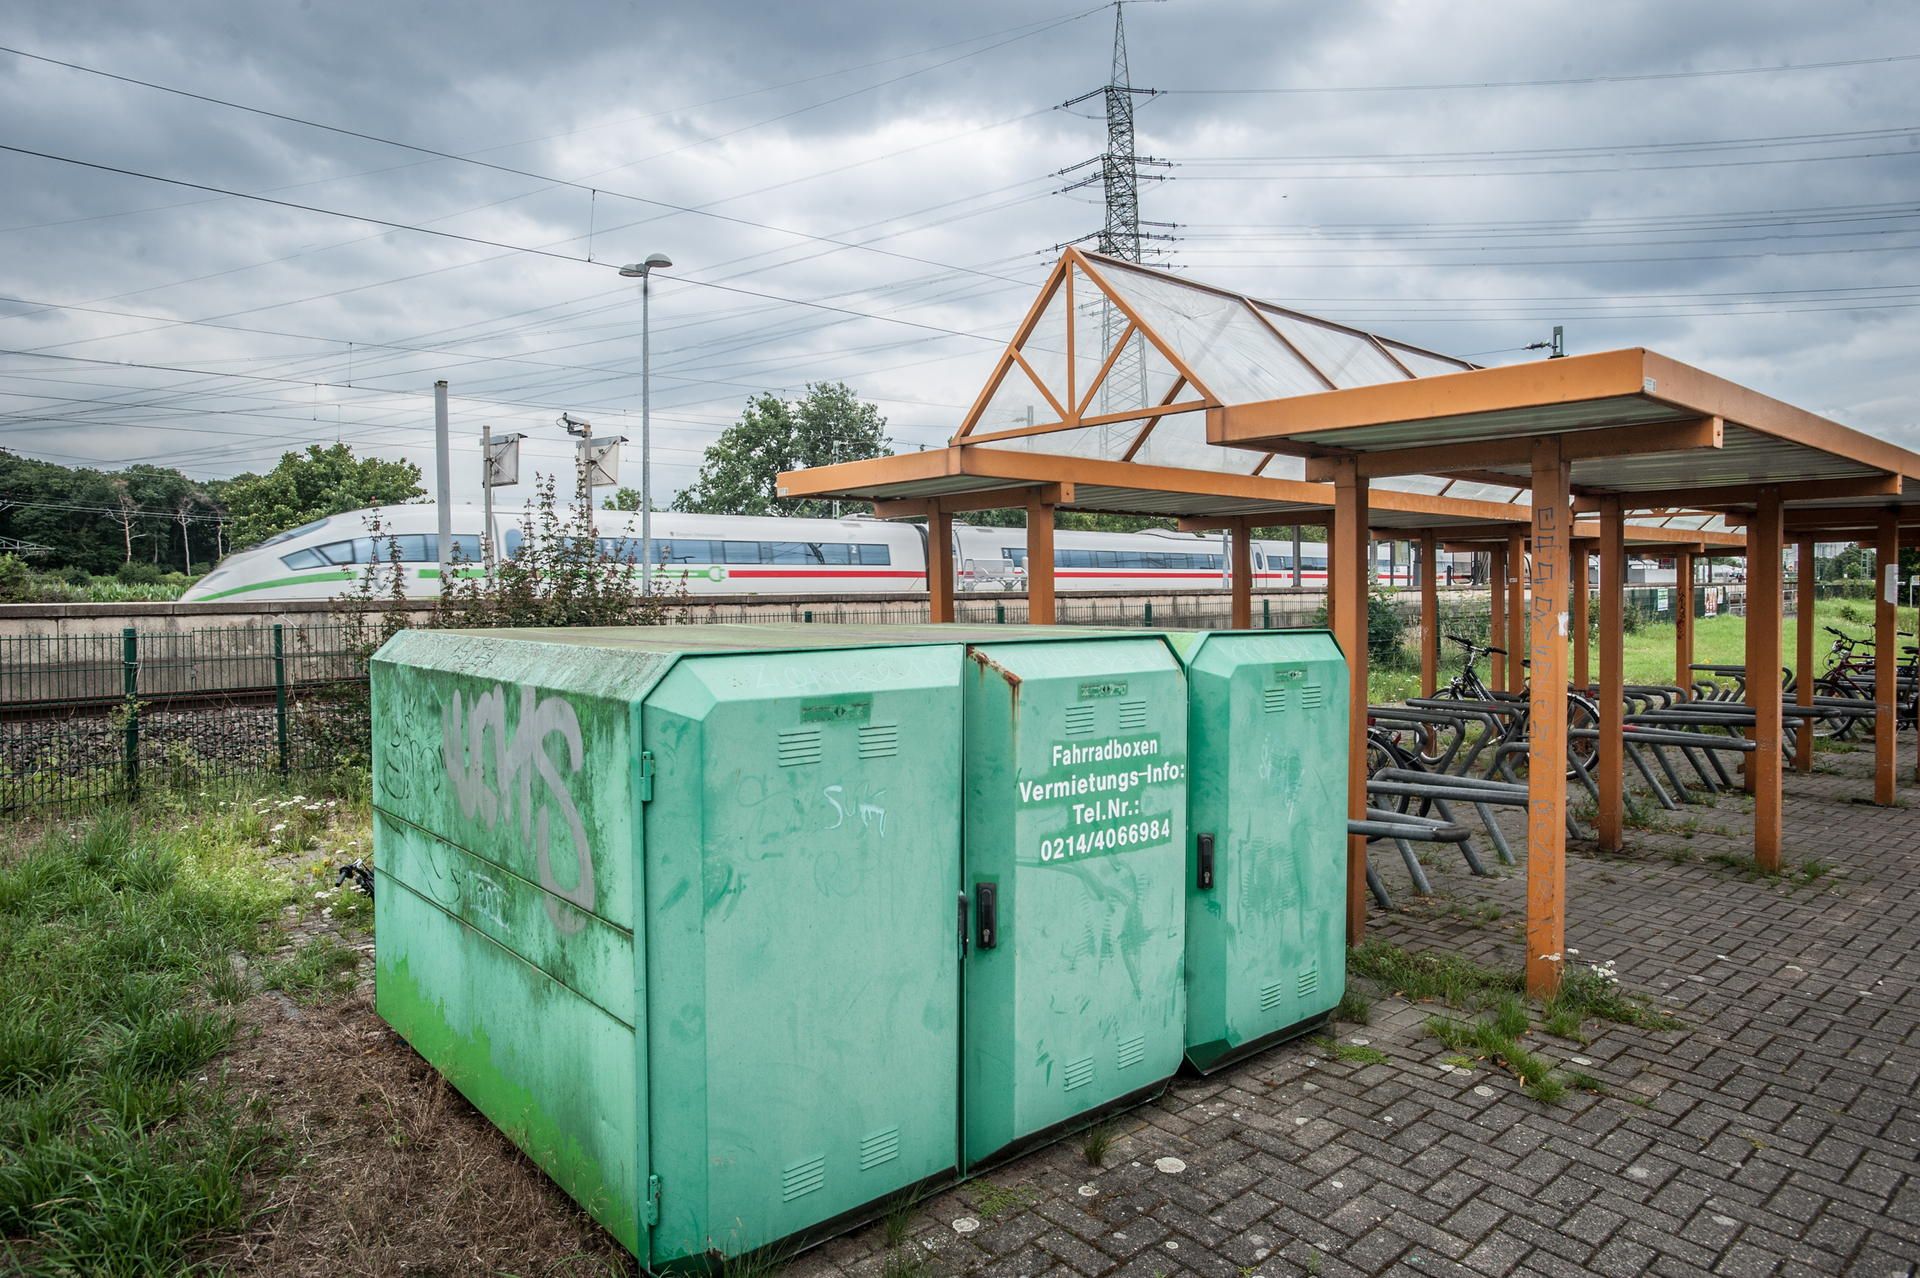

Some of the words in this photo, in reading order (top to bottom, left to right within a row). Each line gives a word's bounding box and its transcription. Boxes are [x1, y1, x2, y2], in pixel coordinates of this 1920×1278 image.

[850, 544, 857, 554] 2
[1052, 738, 1158, 767] Fahrradboxen
[1019, 761, 1185, 803] Vermietungs-Info:
[1072, 799, 1140, 825] Tel.Nr.:
[1040, 819, 1171, 862] 0214/4066984
